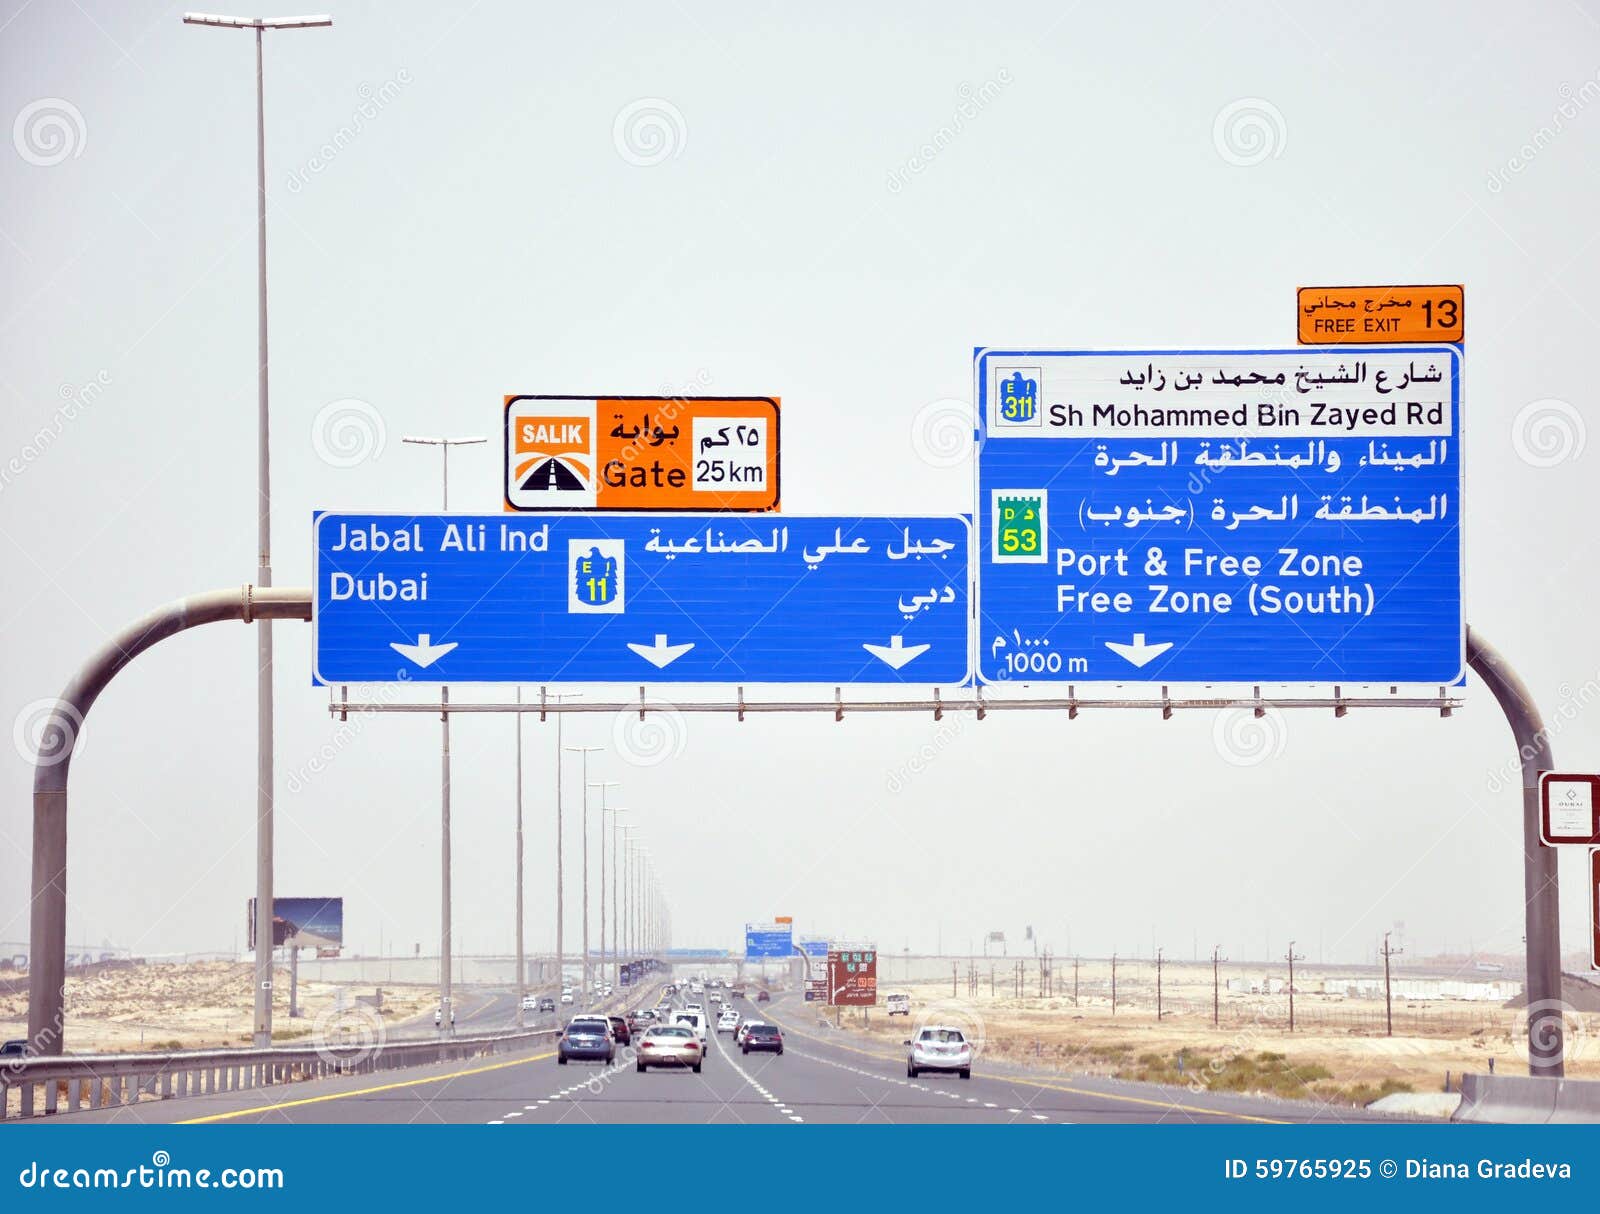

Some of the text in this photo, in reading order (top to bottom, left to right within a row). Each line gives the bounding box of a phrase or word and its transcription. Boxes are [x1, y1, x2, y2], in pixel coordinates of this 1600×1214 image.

[1305, 296, 1413, 316] مخرج مجاني
[1422, 300, 1457, 328] 13
[1315, 319, 1400, 332] FREE EXIT
[1007, 382, 1014, 392] E
[1120, 362, 1441, 394] شارع الشيخ محمد بن زايد
[1005, 397, 1033, 419] 311
[1050, 402, 1442, 430] Sh Mohammed Bin Zayed Rd
[523, 425, 582, 443] SALIK
[611, 415, 679, 446] بوابة
[701, 427, 729, 454] كم
[1095, 440, 1446, 475] الميناء والمنطقة الحرة
[604, 461, 685, 487] Gate
[1005, 509, 1014, 519] D
[1212, 495, 1297, 529] الحرة
[1315, 494, 1446, 523] المنطقة
[333, 524, 548, 551] Jabal Ali Ind
[645, 527, 954, 569] جبل علي الصناعية
[1004, 529, 1036, 551] 53
[583, 562, 591, 573] E
[1057, 547, 1362, 576] Port & Free Zone
[332, 573, 426, 600] Dubai
[586, 578, 608, 602] 11
[1058, 584, 1374, 615] Free Zone (South)
[899, 587, 955, 619] دبي
[1006, 653, 1087, 672] 1000 m
